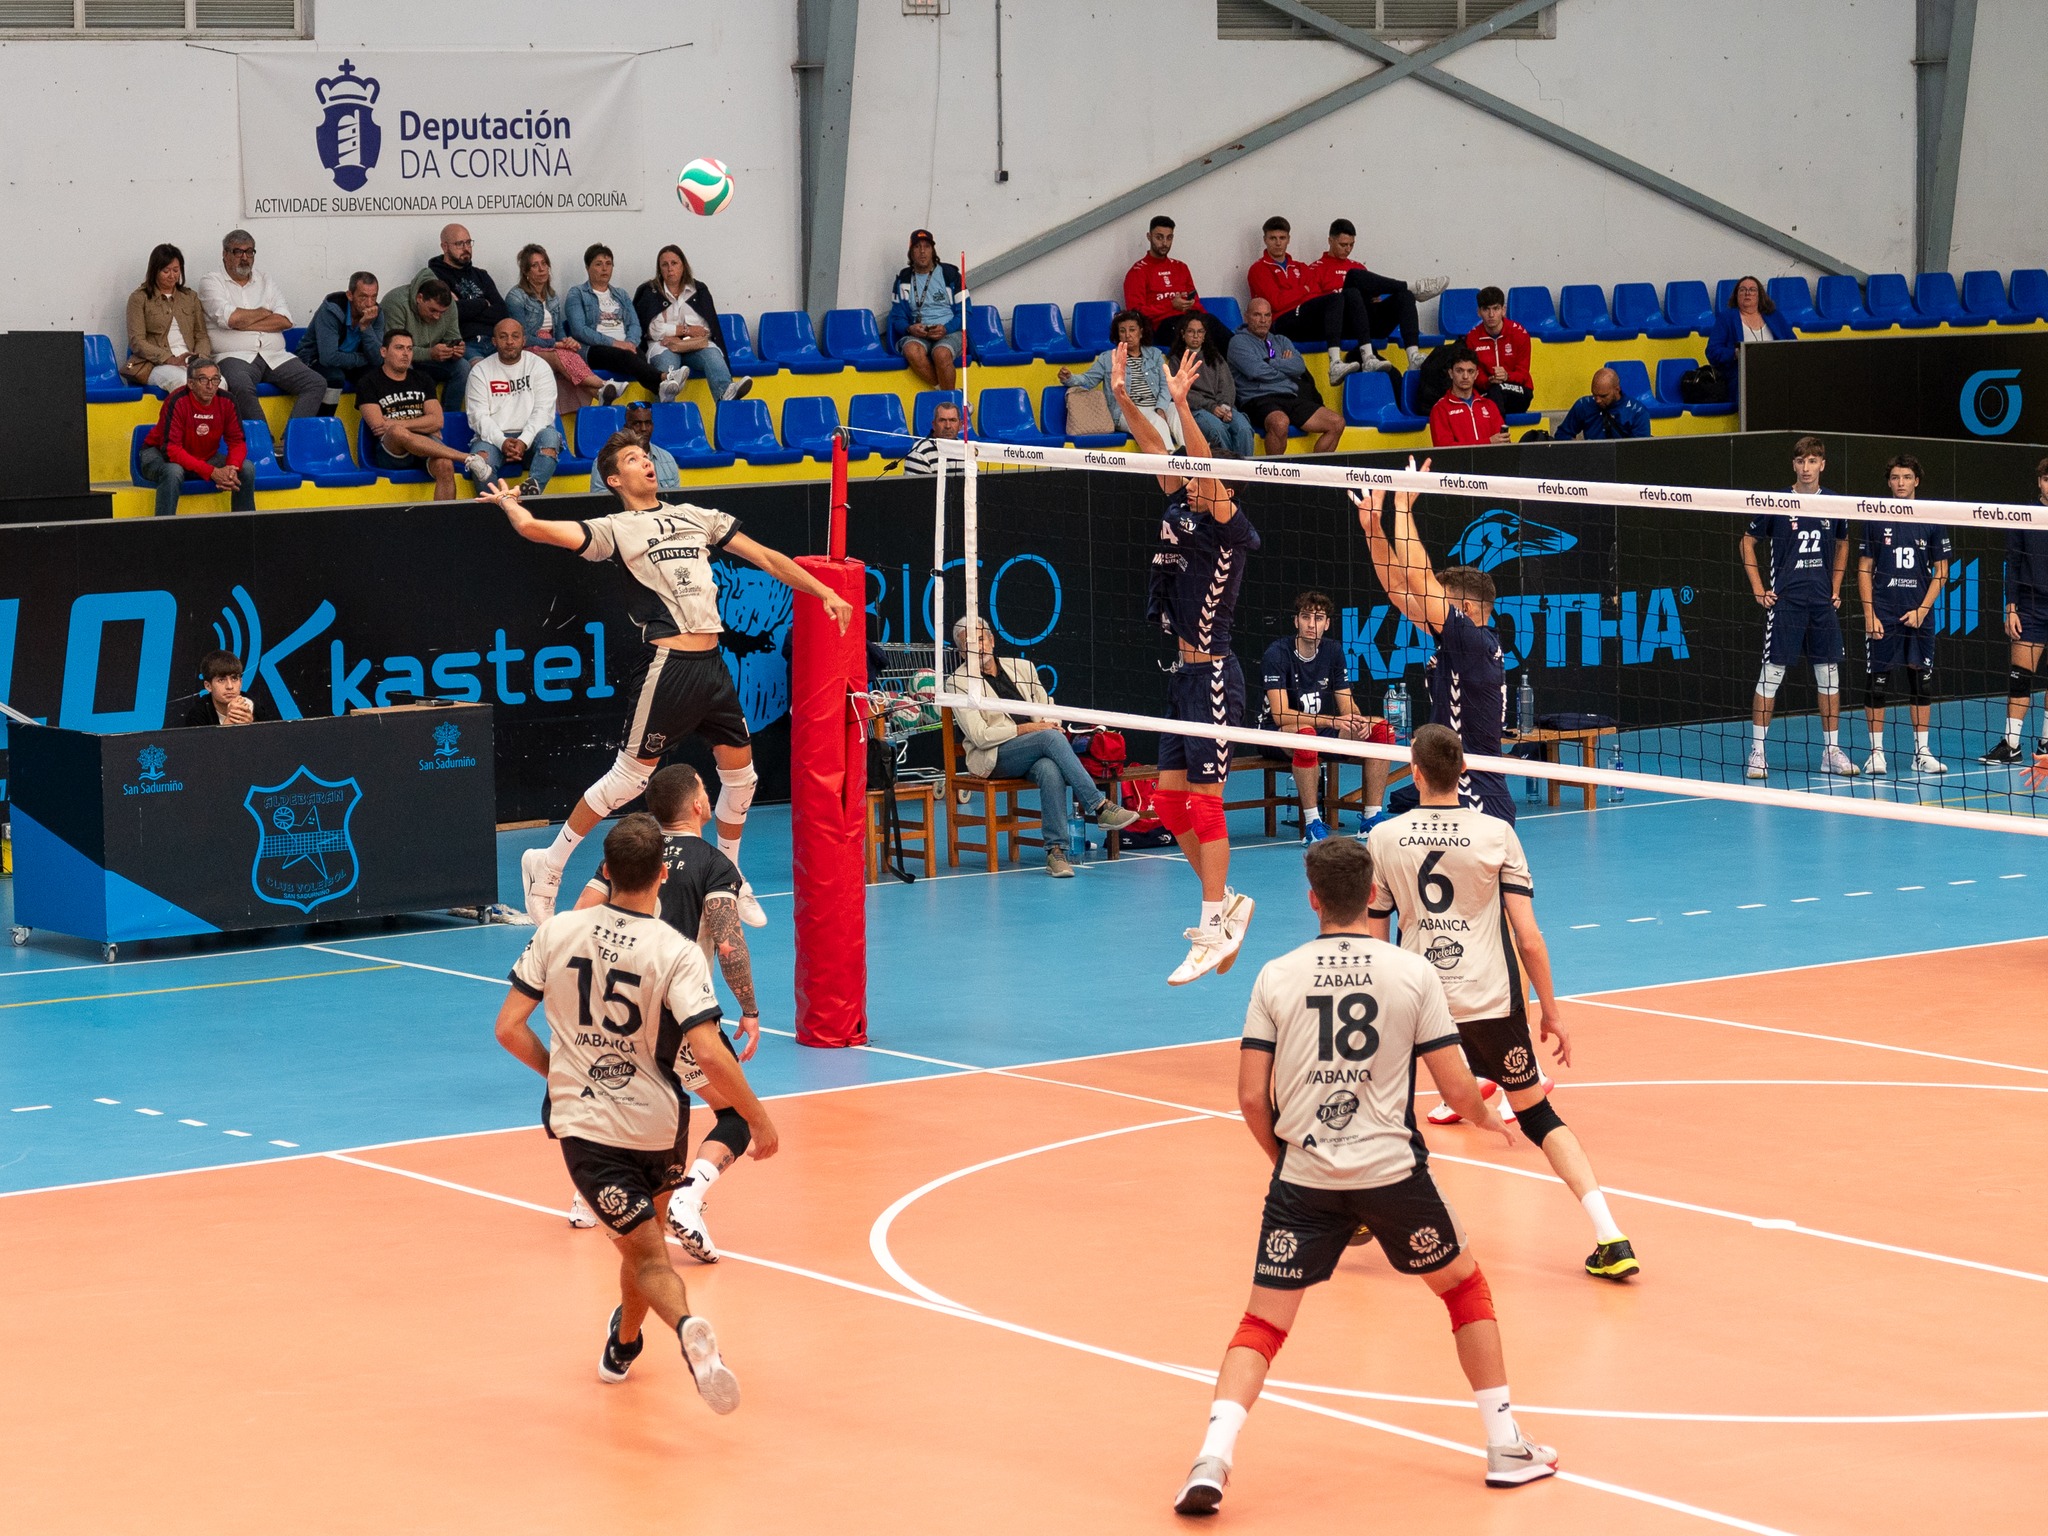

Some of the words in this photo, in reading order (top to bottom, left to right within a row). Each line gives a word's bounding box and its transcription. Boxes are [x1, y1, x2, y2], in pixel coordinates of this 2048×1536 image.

[400, 109, 571, 149] Deputación
[401, 150, 440, 178] DA
[450, 143, 572, 178] CORUÑA
[254, 198, 327, 213] ACTIVIDADE
[332, 196, 437, 212] SUBVENCIONADA
[441, 195, 473, 210] POLA
[477, 191, 553, 209] DEPUTACIÓN
[557, 193, 574, 207] DA
[577, 190, 628, 207] CORUÑA
[1003, 448, 1044, 460] rfevb.com
[1084, 452, 1126, 466] rfevb.com
[1168, 458, 1211, 472] rfevb.com
[1255, 465, 1300, 478] rfevb.com
[1346, 470, 1392, 484] rfevb.com
[1439, 477, 1488, 490] rfevb.com
[1537, 483, 1588, 497] rfevb.com
[1639, 488, 1692, 503] rfevb.com
[1745, 494, 1800, 509] rfevb.com
[1856, 500, 1914, 515] rfevb.com
[1972, 507, 2032, 522] rfevb.com
[653, 518, 675, 535] 11
[1797, 529, 1821, 553] 22
[1893, 546, 1915, 569] 13
[331, 621, 615, 716] kastel
[418, 759, 434, 771] San
[435, 755, 476, 770] Sadurniño
[123, 783, 139, 796] San
[140, 779, 183, 794] Sadurniño
[264, 790, 344, 809] ALDEBARAN
[1399, 835, 1471, 848] CAAMAÑO
[266, 876, 295, 893] CLUB
[1418, 850, 1454, 914] 6
[598, 945, 619, 963] TEO
[1313, 973, 1373, 988] ZABALA
[566, 956, 643, 1037] 15
[1306, 992, 1380, 1062] 18
[1501, 1066, 1536, 1085] SEMILLAS
[605, 1194, 620, 1207] LG
[612, 1198, 648, 1229] SEMILLAS
[1275, 1237, 1288, 1253] LG
[1256, 1263, 1303, 1280] SEMILLAS
